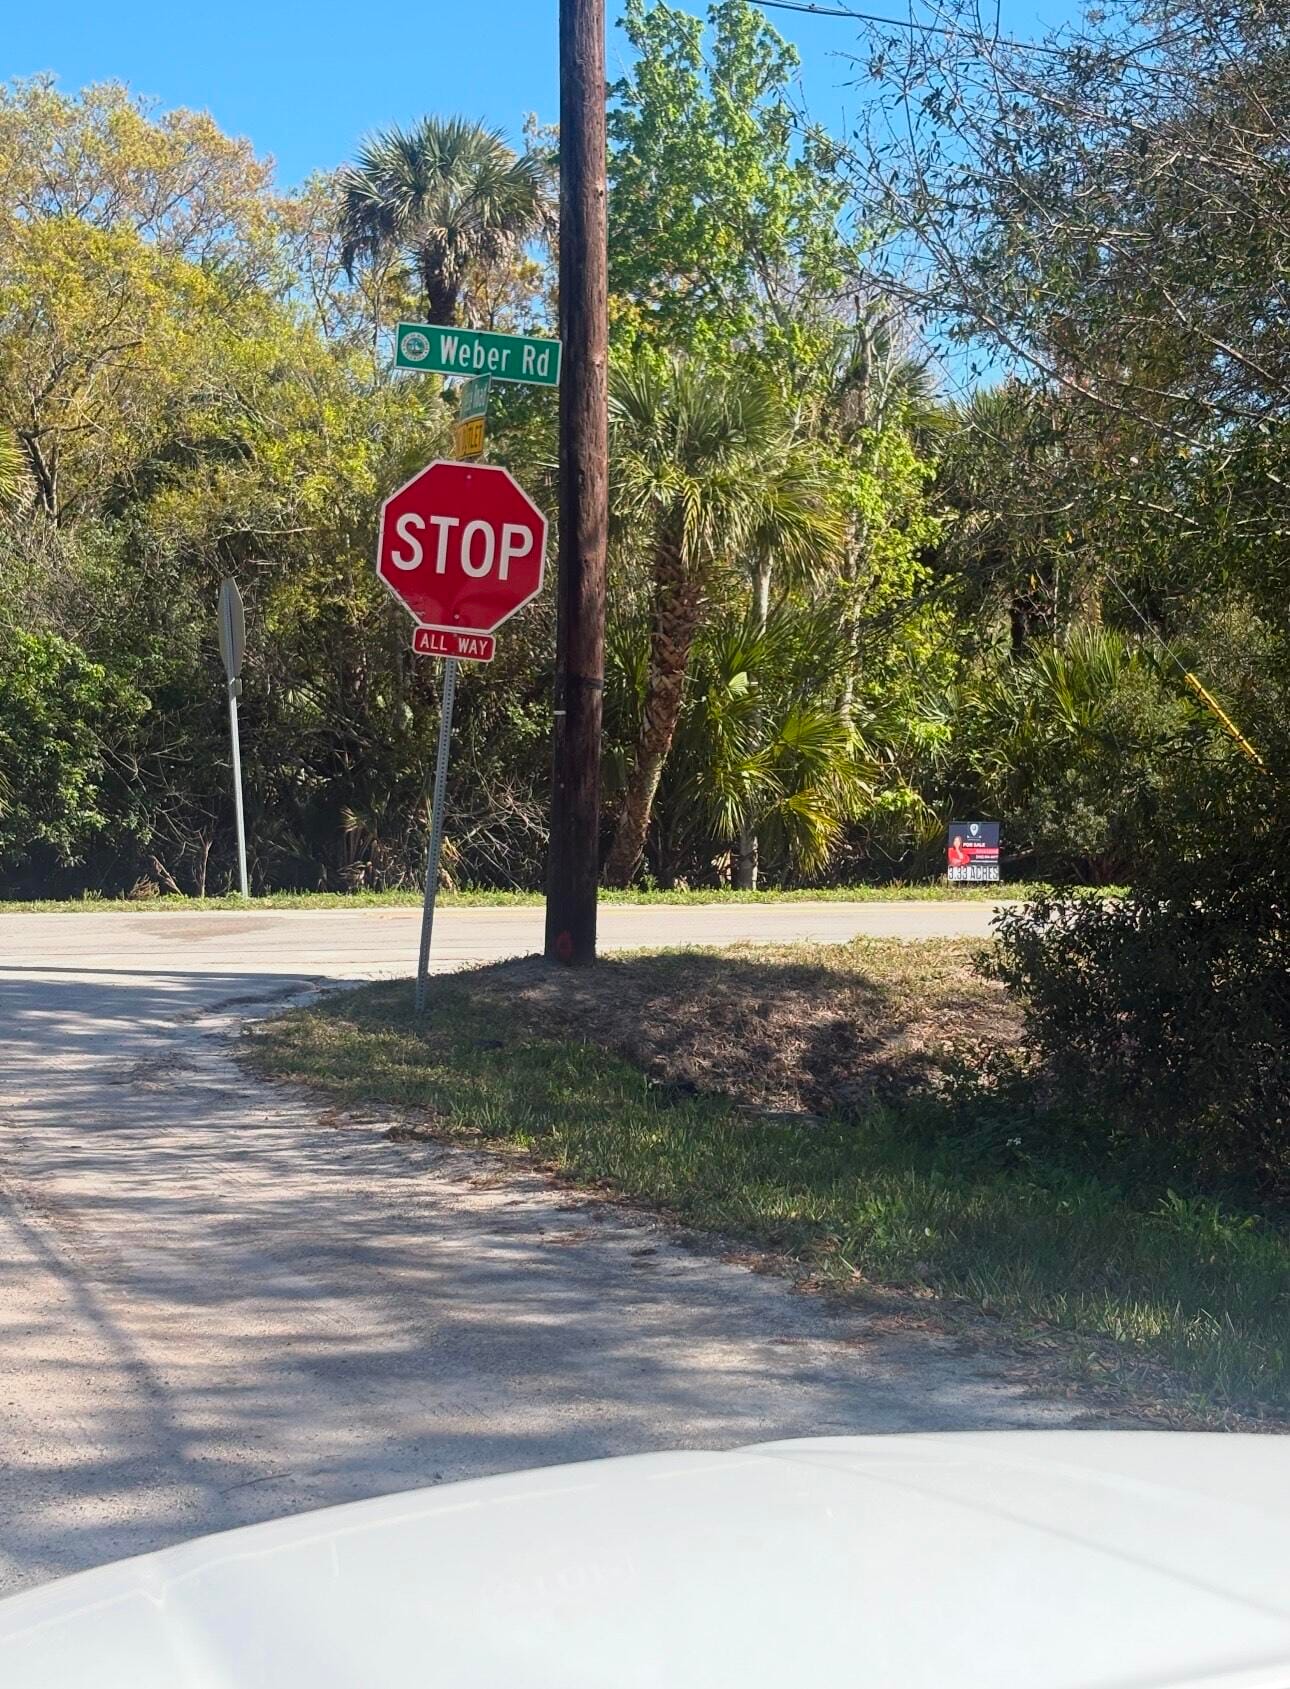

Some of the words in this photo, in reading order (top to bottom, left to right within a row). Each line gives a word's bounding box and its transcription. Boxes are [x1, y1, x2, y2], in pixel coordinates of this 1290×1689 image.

[440, 335, 511, 371] Weber
[522, 345, 550, 377] Rd
[391, 512, 534, 581] STOP
[420, 633, 448, 651] ALL
[458, 637, 489, 656] WAY
[970, 866, 998, 879] ACRES
